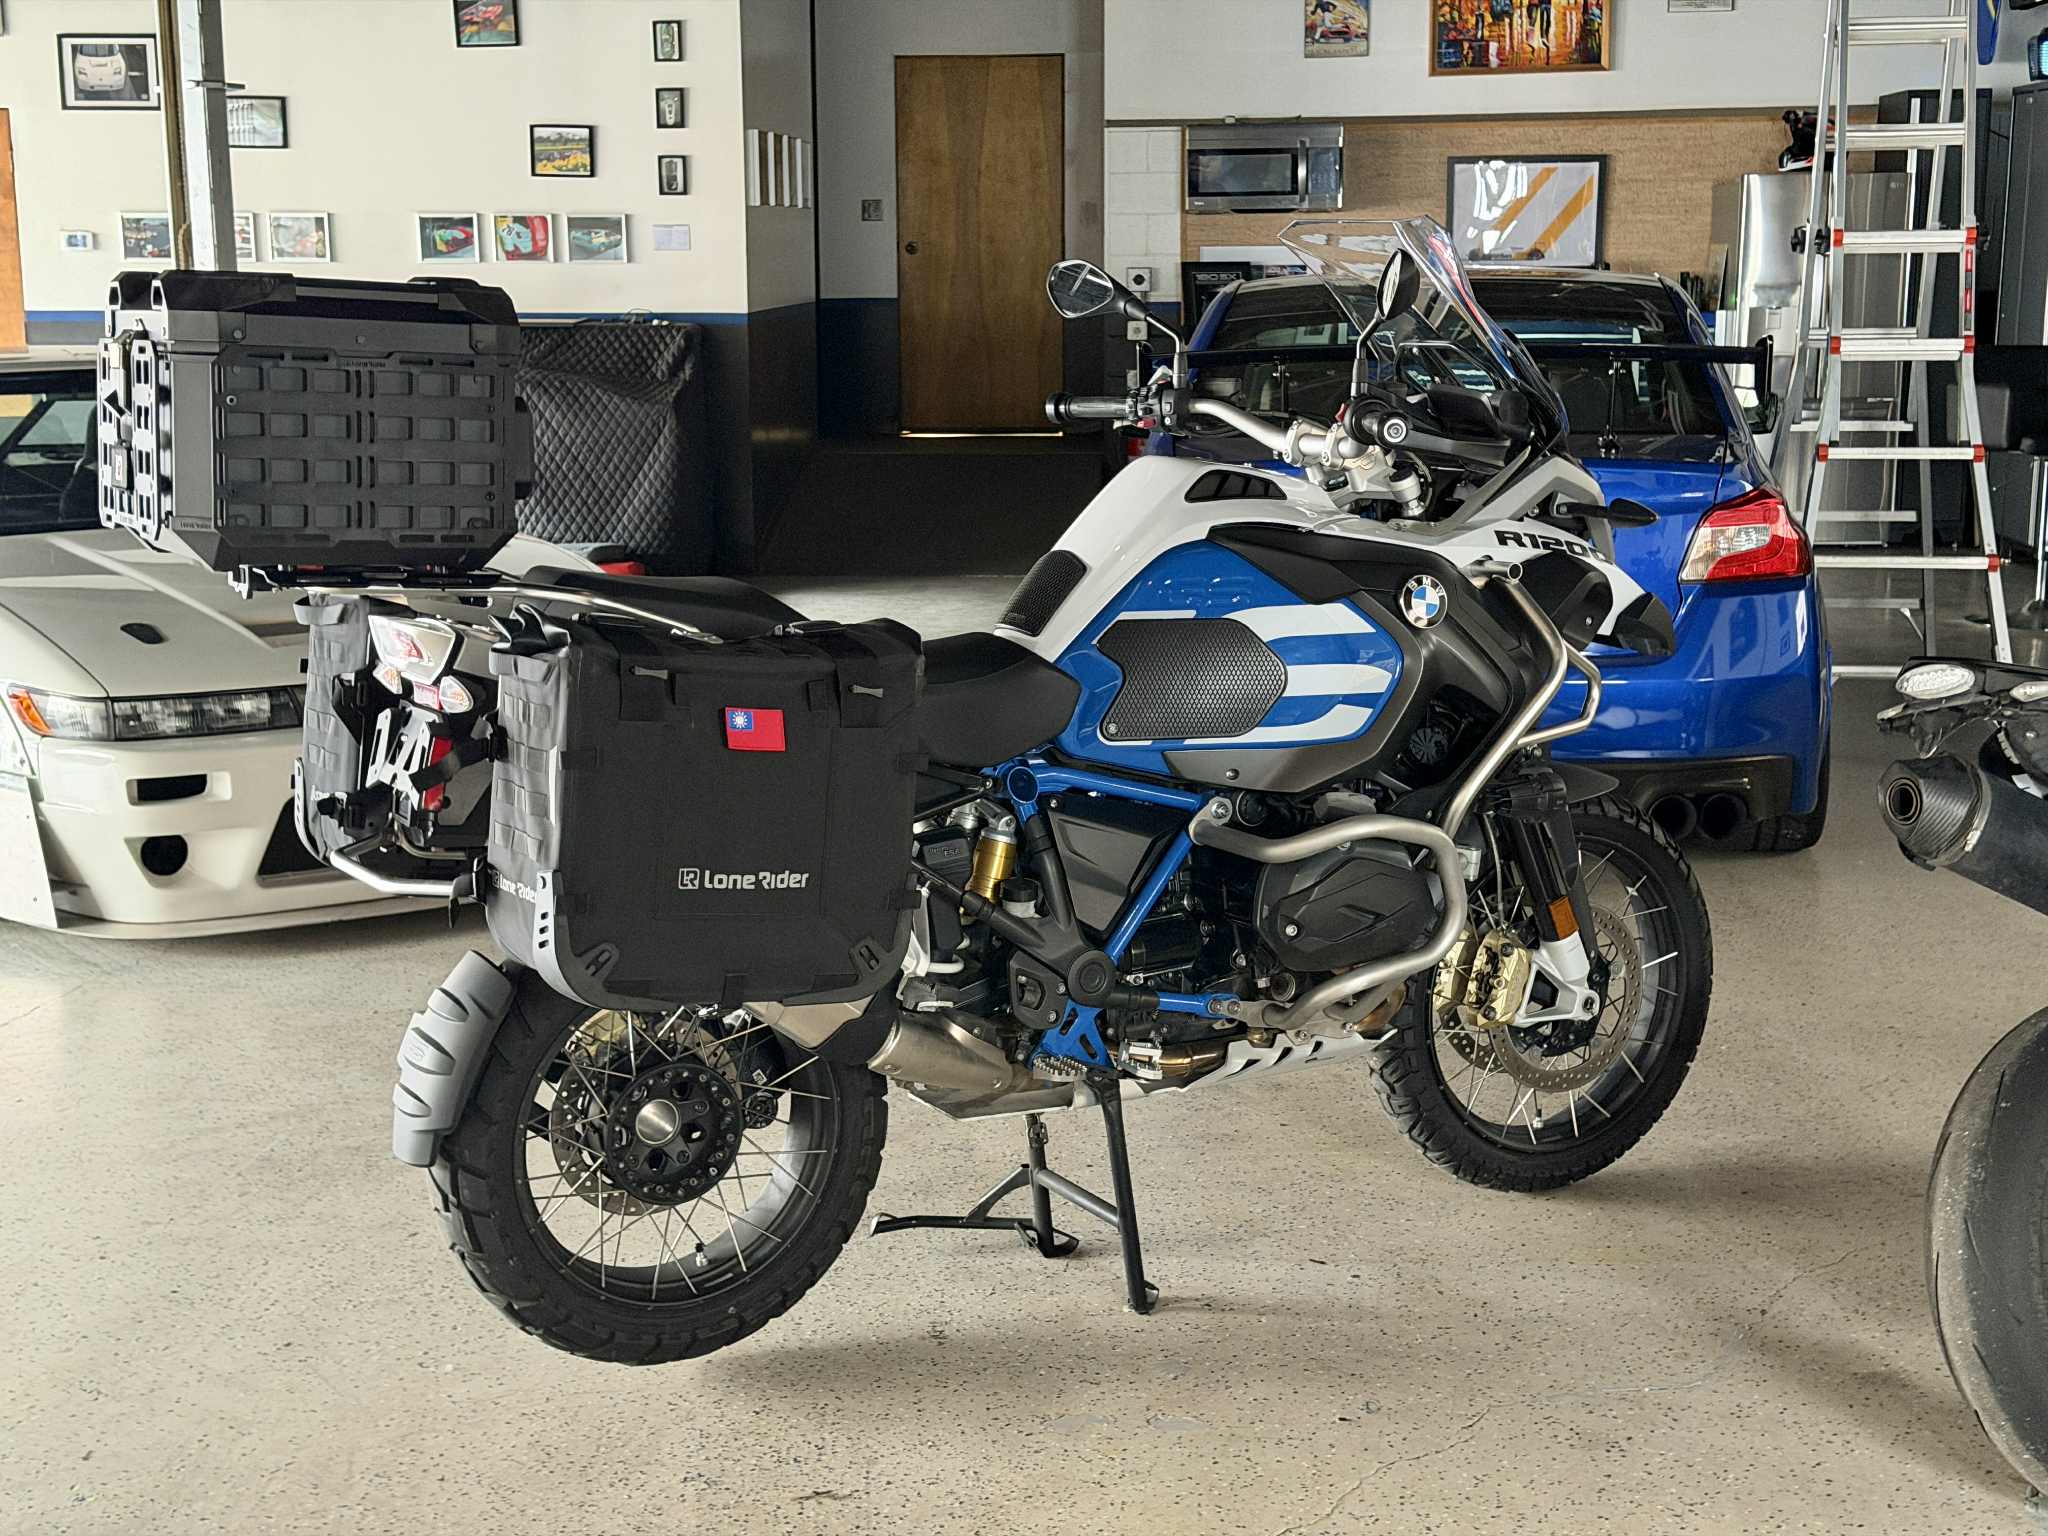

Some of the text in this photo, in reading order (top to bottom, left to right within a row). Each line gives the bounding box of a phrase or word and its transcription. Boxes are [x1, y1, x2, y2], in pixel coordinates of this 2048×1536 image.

[499, 873, 517, 897] Lone
[703, 869, 756, 890] Lone
[758, 870, 810, 890] Rider
